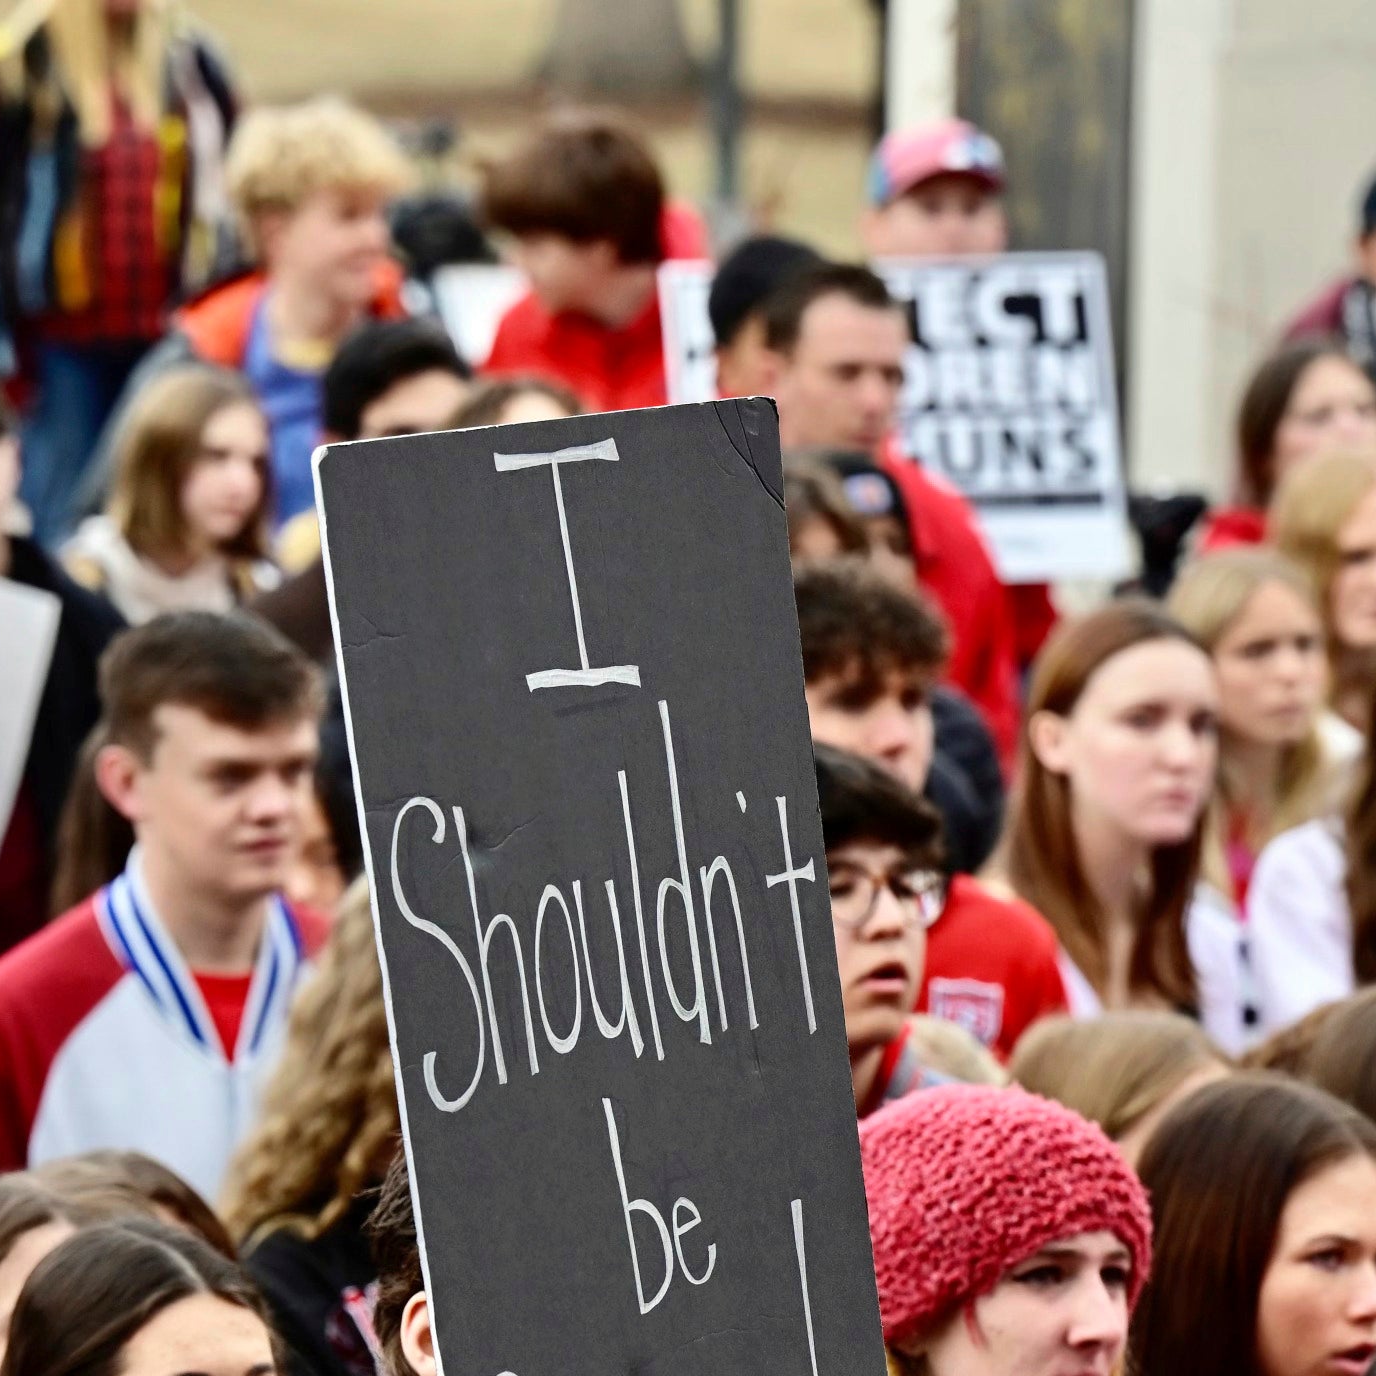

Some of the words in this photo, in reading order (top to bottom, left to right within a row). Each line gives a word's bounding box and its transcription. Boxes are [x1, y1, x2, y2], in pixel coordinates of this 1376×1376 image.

[494, 437, 640, 692] I
[390, 700, 815, 1113] Shouldn't
[602, 1097, 716, 1314] be
